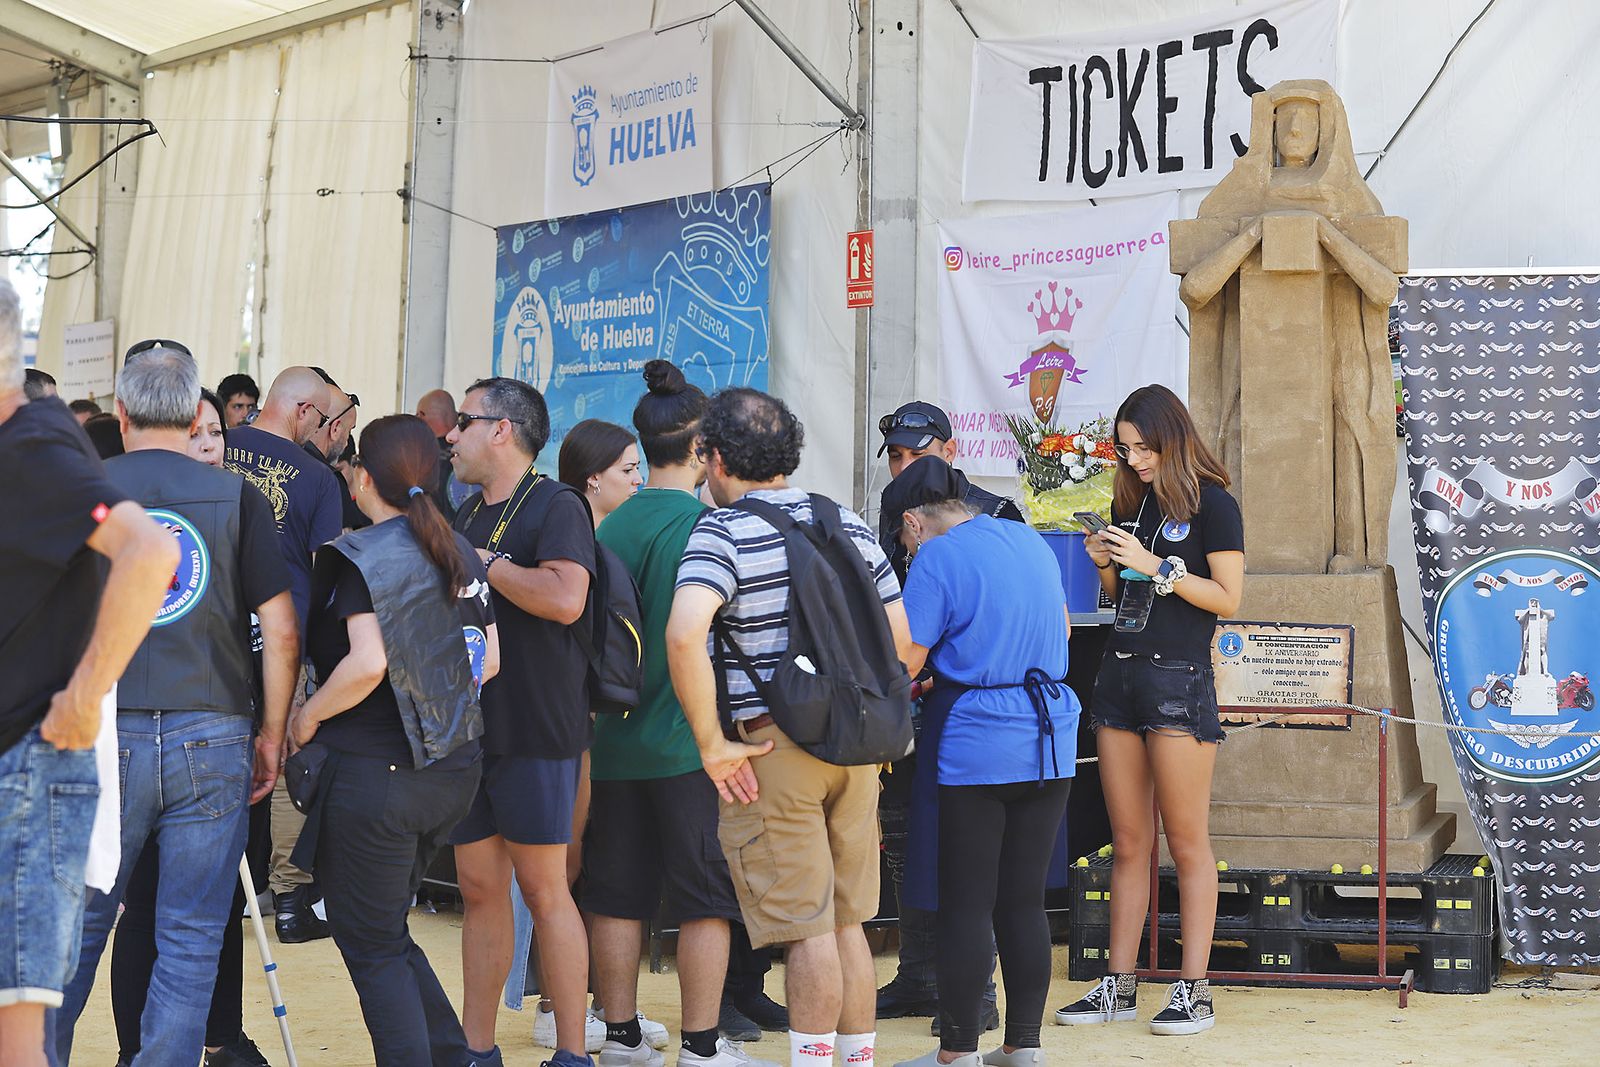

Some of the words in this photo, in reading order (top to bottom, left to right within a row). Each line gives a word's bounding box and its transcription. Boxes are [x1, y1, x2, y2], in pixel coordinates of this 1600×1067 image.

[611, 80, 683, 118] Ayuntamiento
[686, 72, 698, 94] de
[1029, 18, 1278, 188] TICKETS
[609, 108, 696, 165] HUELVA
[554, 290, 655, 329] Ayuntamiento
[848, 290, 873, 300] EXTINTOR
[581, 326, 598, 351] de
[603, 322, 654, 350] Huelva
[699, 307, 730, 342] TERRA
[598, 360, 621, 372] Cultura
[1034, 352, 1063, 370] Leire
[226, 447, 253, 464] BORN
[257, 454, 271, 468] TO
[274, 459, 300, 480] RIDE
[1436, 477, 1464, 508] UNA
[1505, 480, 1516, 497] Y
[1521, 480, 1552, 501] NOS
[1584, 492, 1600, 514] VA
[491, 521, 506, 544] Nikon
[1483, 575, 1498, 588] UNA
[1526, 577, 1543, 585] NOS
[1558, 572, 1585, 590] VAMOS
[1275, 649, 1320, 657] ANIVERSARIO
[1237, 696, 1280, 704] VUESTRA
[1257, 690, 1298, 698] GRACIAS
[1440, 619, 1450, 683] GRUPO
[1490, 735, 1600, 770] DESCUBRIDO
